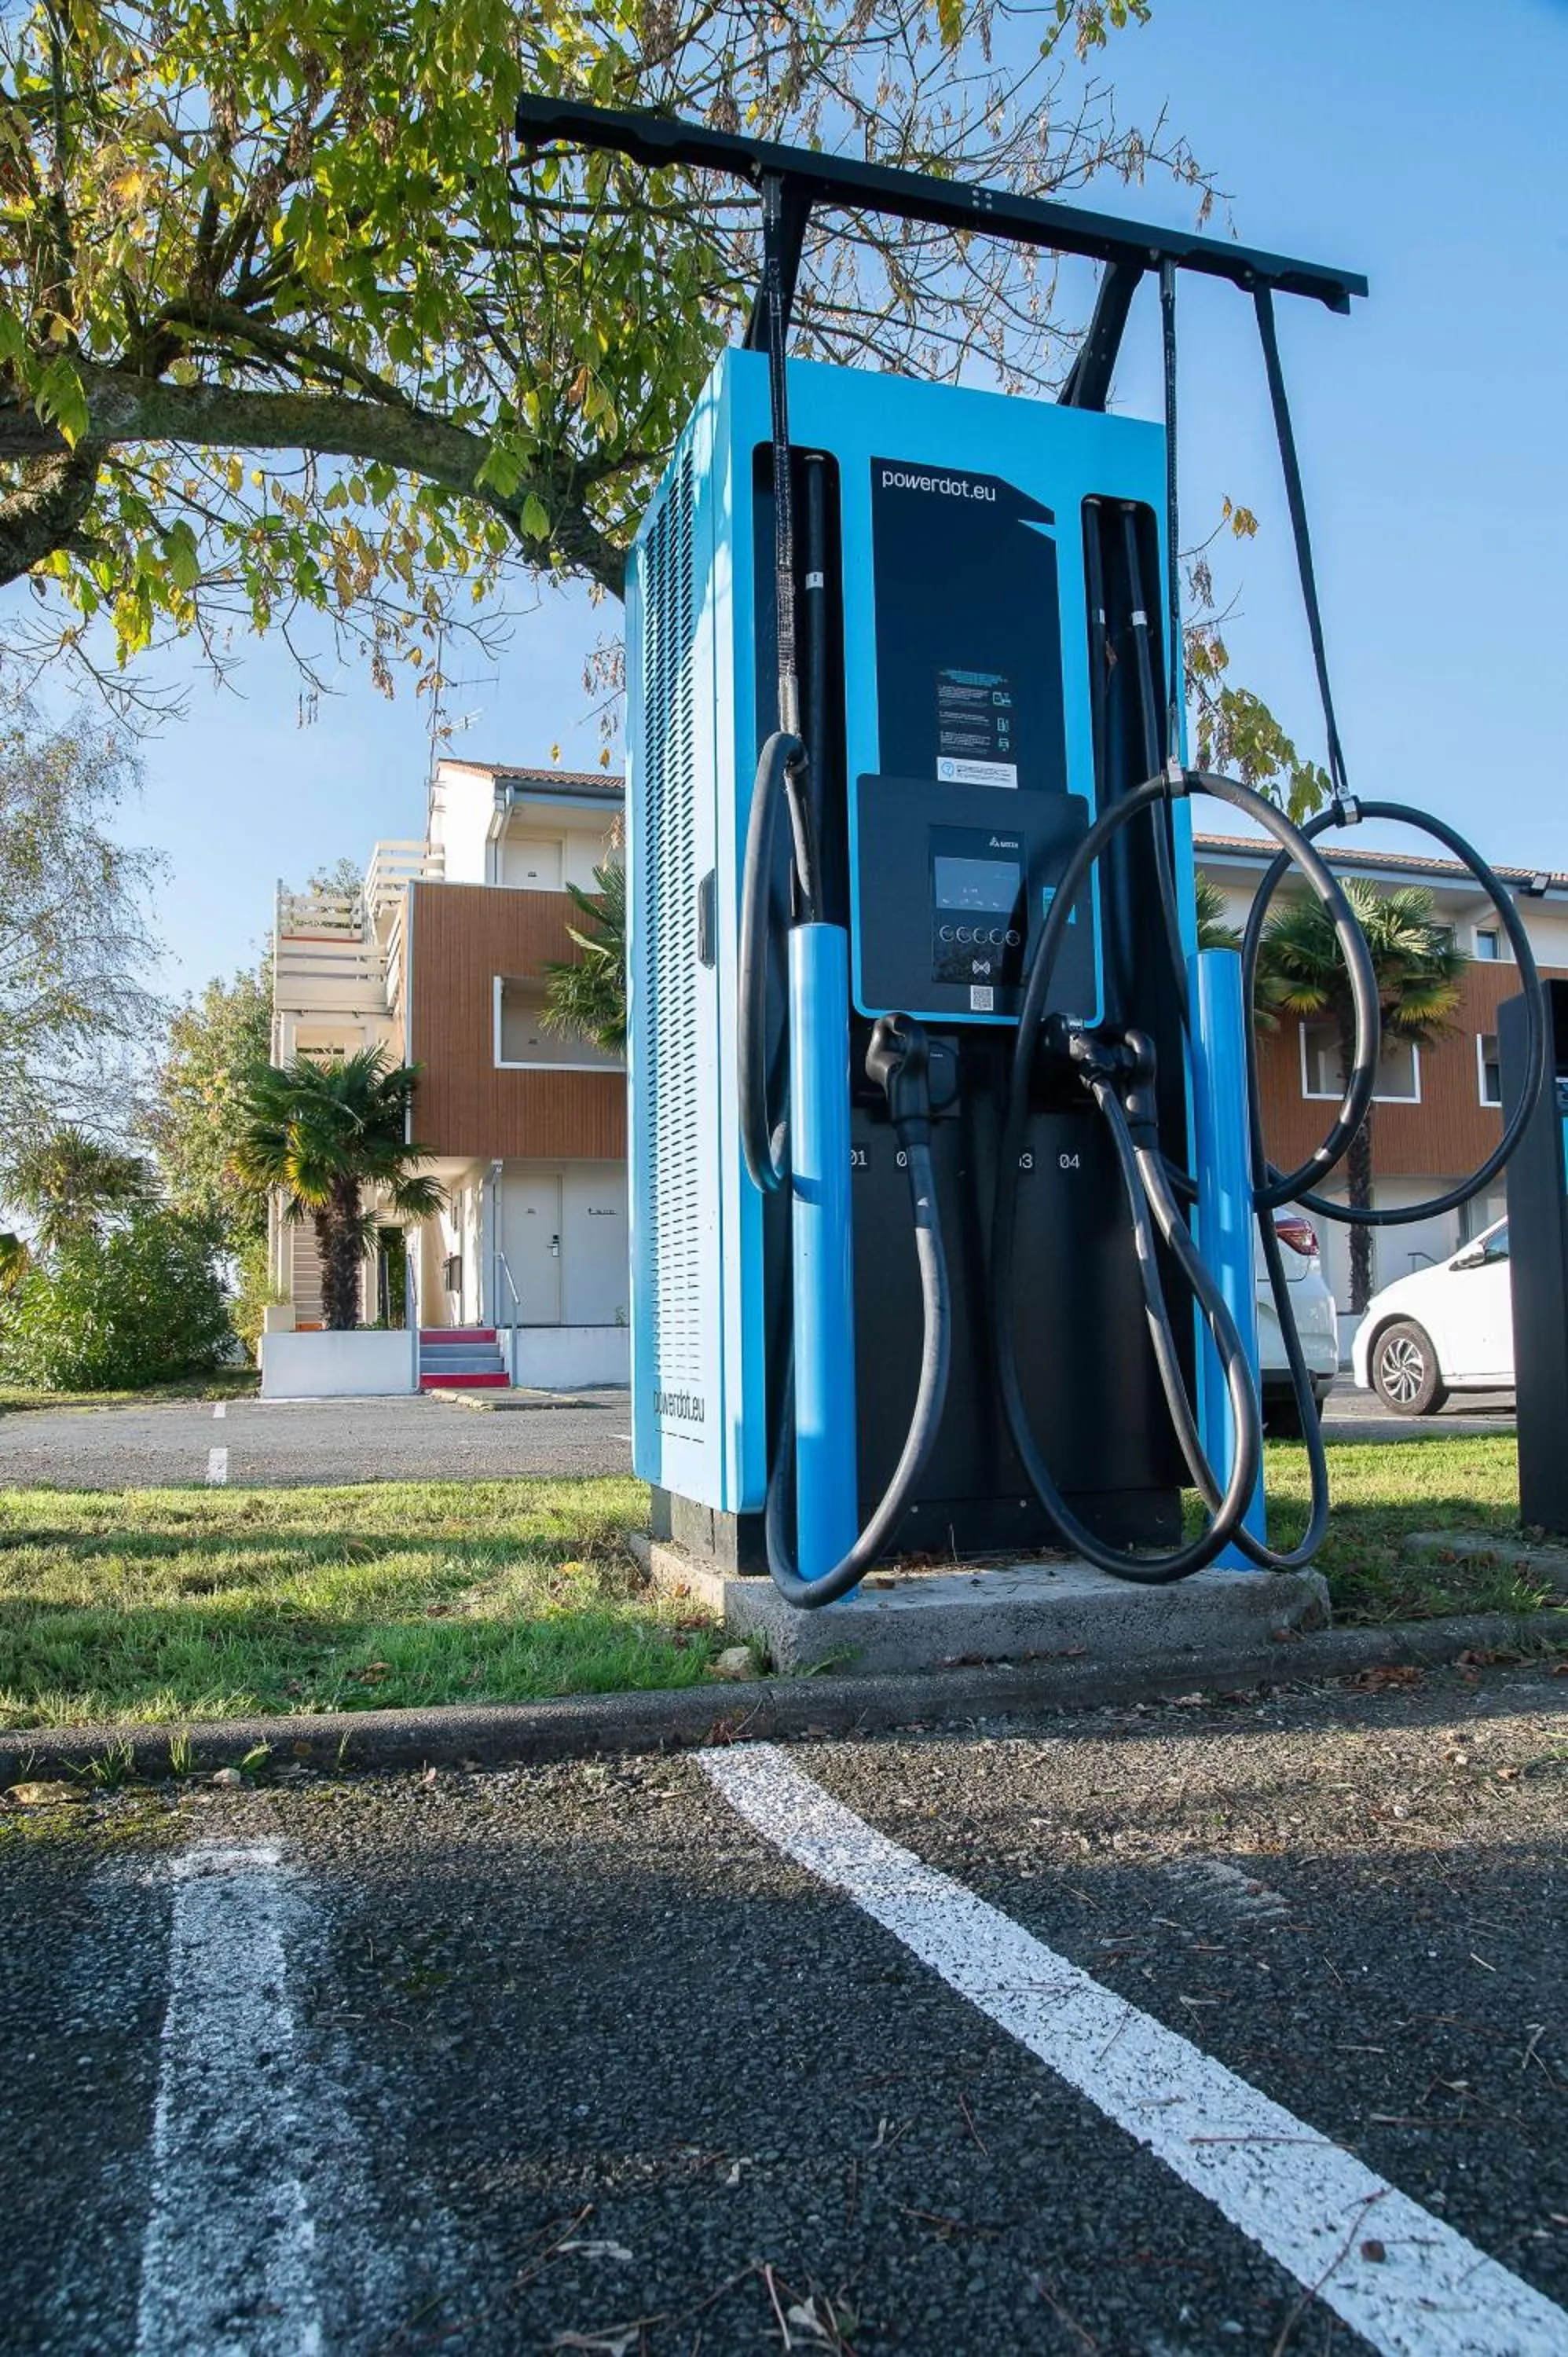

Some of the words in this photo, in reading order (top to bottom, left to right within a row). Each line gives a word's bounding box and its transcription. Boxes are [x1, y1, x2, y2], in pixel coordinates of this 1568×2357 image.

[881, 469, 996, 501] powerdot.eu
[896, 1151, 908, 1167] 0
[1019, 1153, 1033, 1168] 3
[1059, 1153, 1080, 1168] 04
[654, 1389, 705, 1423] powerdot.eu
